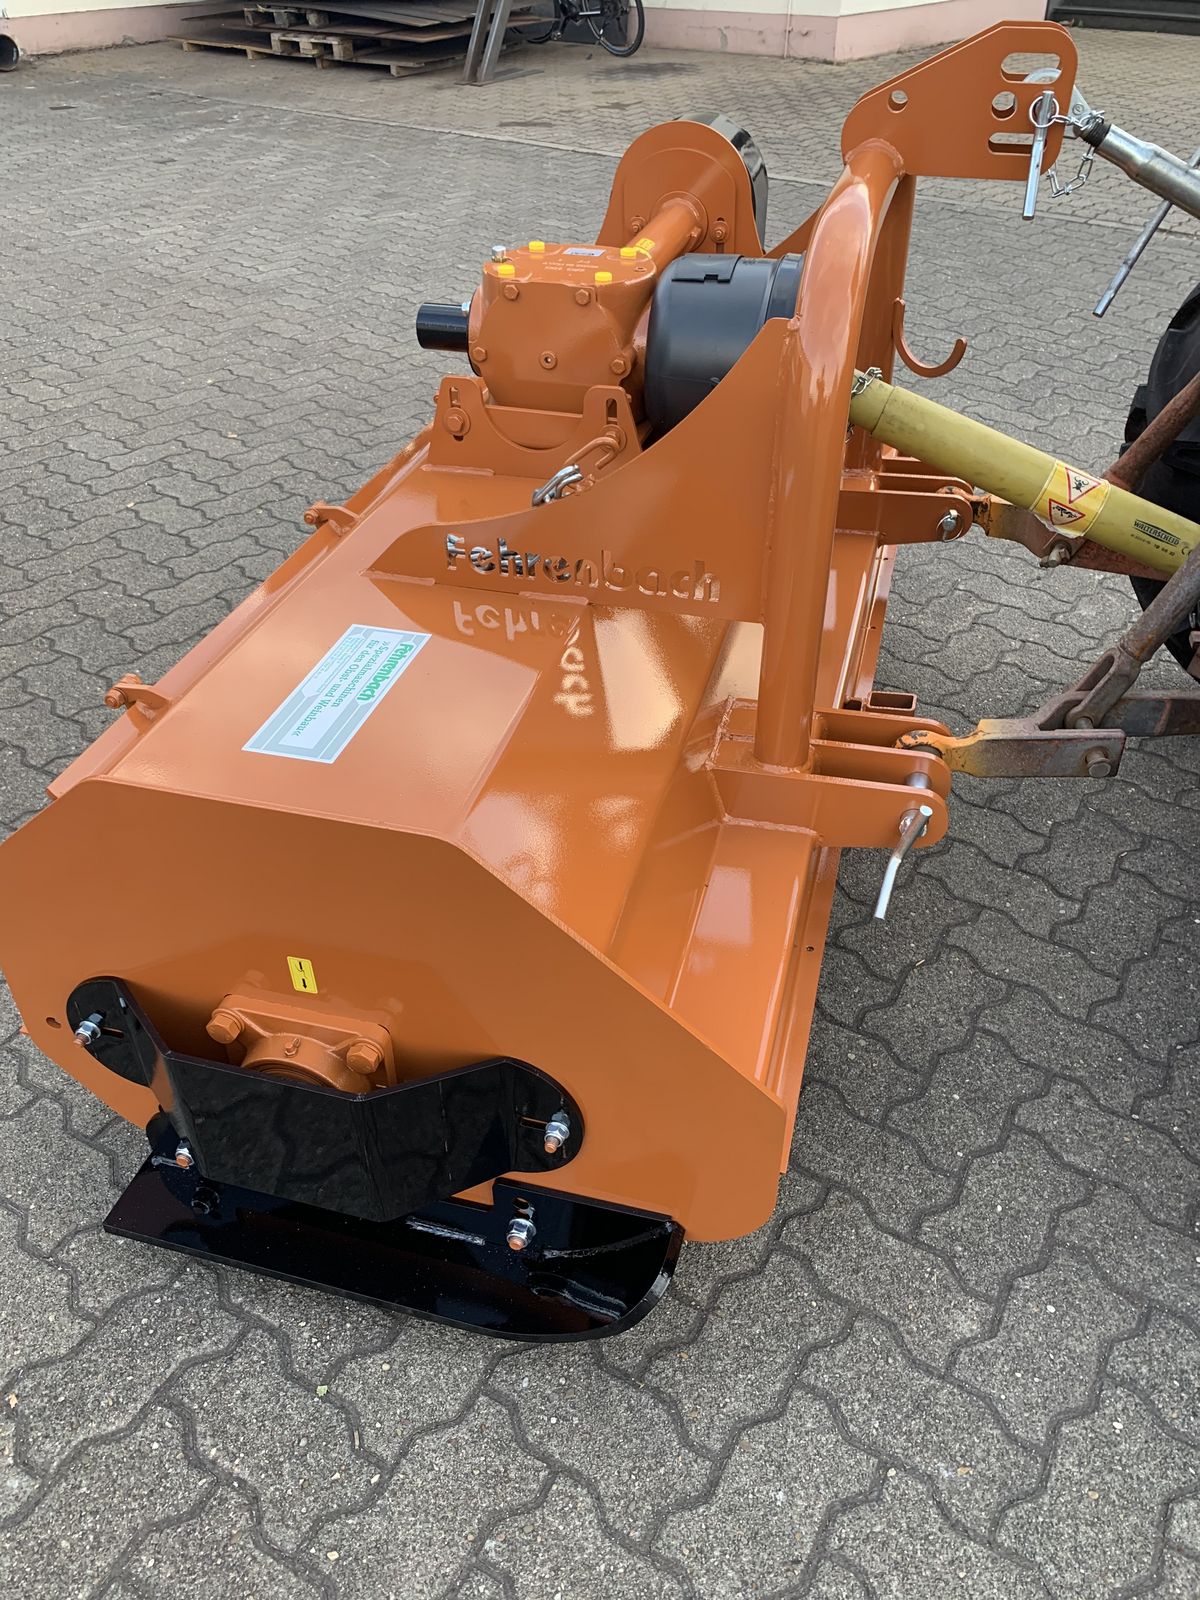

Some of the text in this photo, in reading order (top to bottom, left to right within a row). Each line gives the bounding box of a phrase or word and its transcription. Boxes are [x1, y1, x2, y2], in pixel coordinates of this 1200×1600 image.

[1134, 520, 1180, 546] WALTERSCHEID
[446, 533, 721, 603] Fehrenbach
[354, 650, 371, 662] den
[356, 642, 415, 701] Fehrenbach
[324, 683, 342, 697] und
